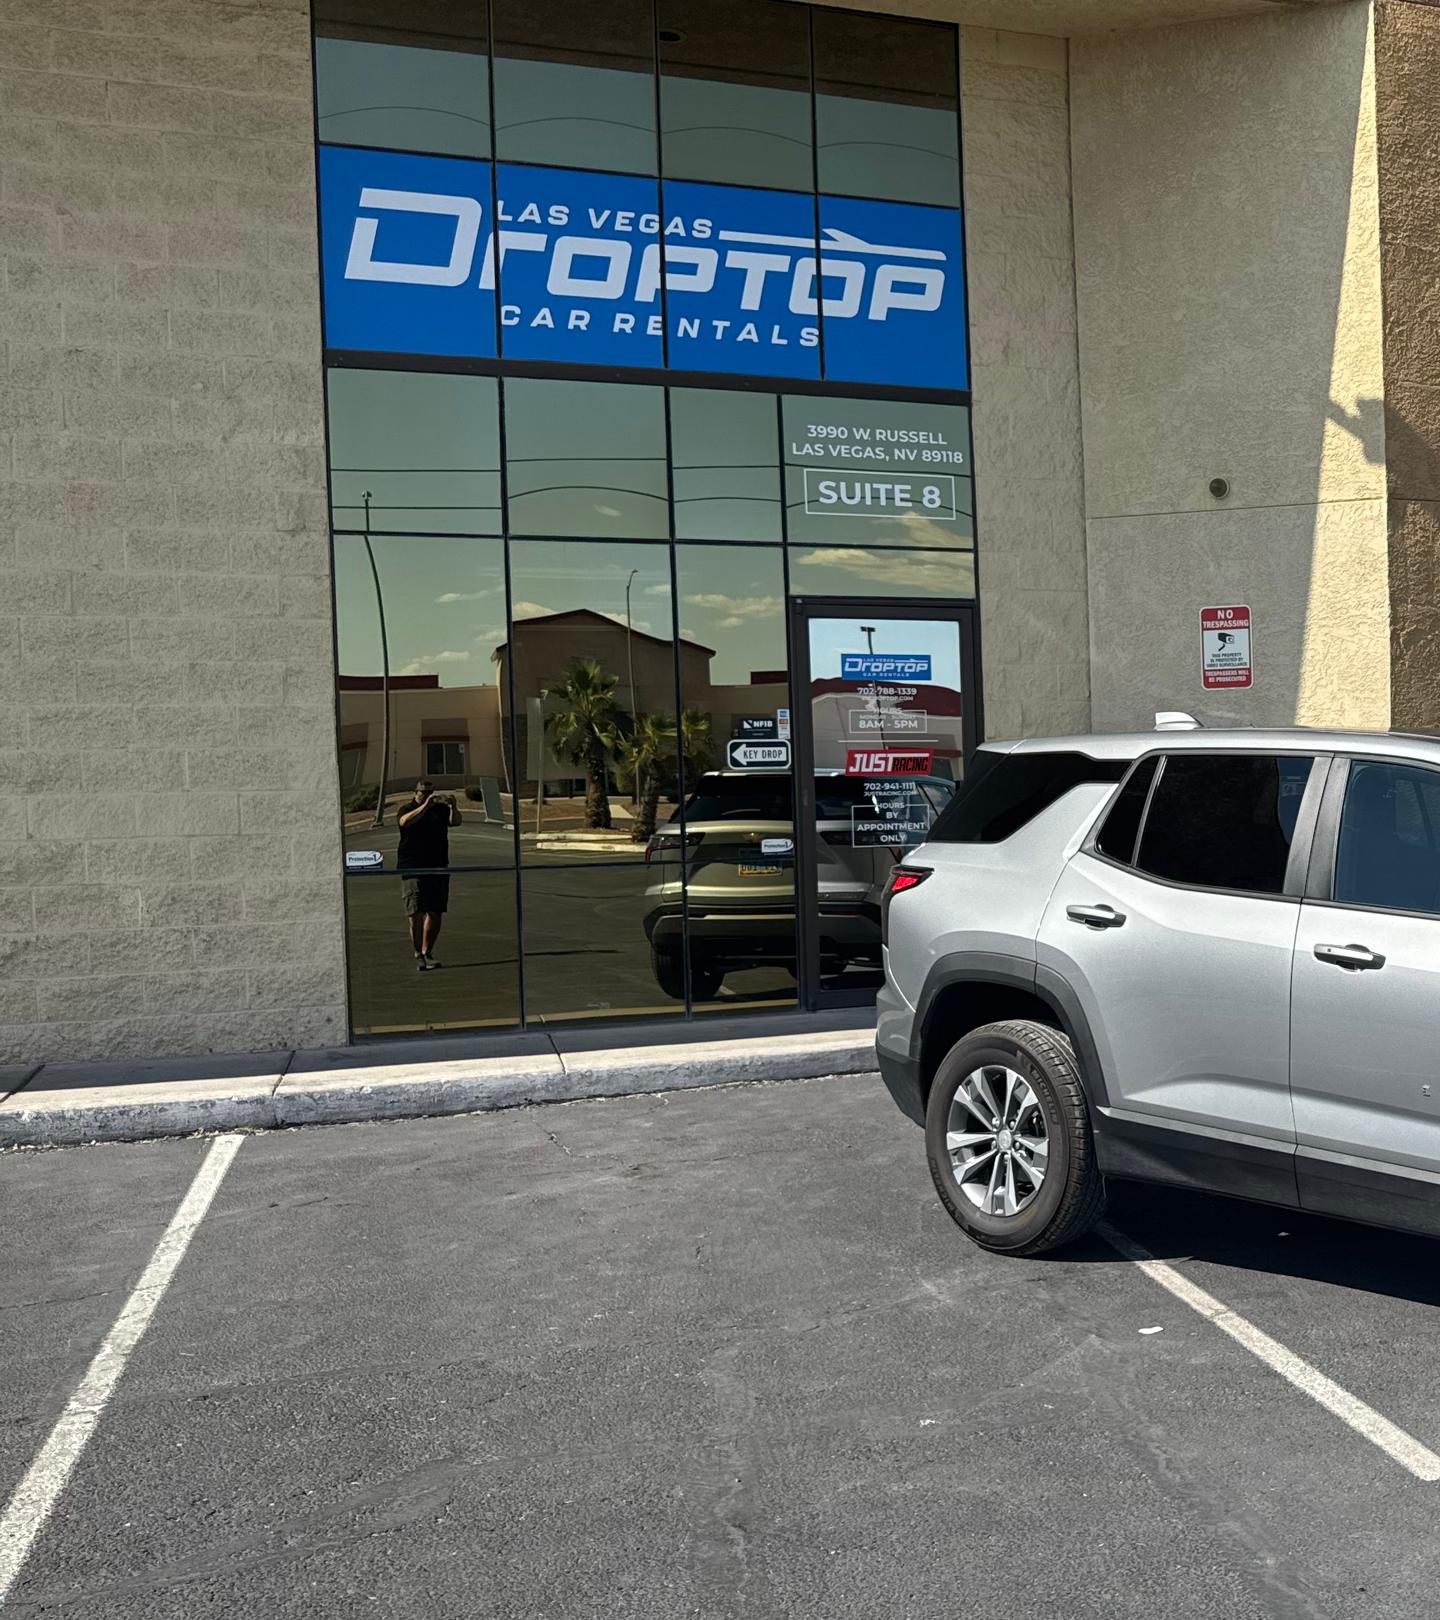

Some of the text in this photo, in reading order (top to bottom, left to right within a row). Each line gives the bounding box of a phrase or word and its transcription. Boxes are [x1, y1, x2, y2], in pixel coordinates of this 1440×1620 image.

[497, 199, 713, 239] LAS VEGAS
[500, 304, 821, 347] CAR RENTALS
[807, 425, 848, 439] 3990
[875, 429, 948, 445] RUSSELL
[792, 443, 964, 464] LAS VEGAS, NV 89118
[818, 480, 942, 509] SUITE 8
[1217, 609, 1234, 619] NO
[1202, 619, 1249, 628] TRESPASSING
[859, 720, 884, 729] 8AM
[894, 720, 918, 729] 5PM
[743, 749, 783, 759] KEY DROP
[886, 811, 899, 819] BY
[857, 822, 926, 832] APPOINTMENT
[880, 834, 906, 842] ONLY
